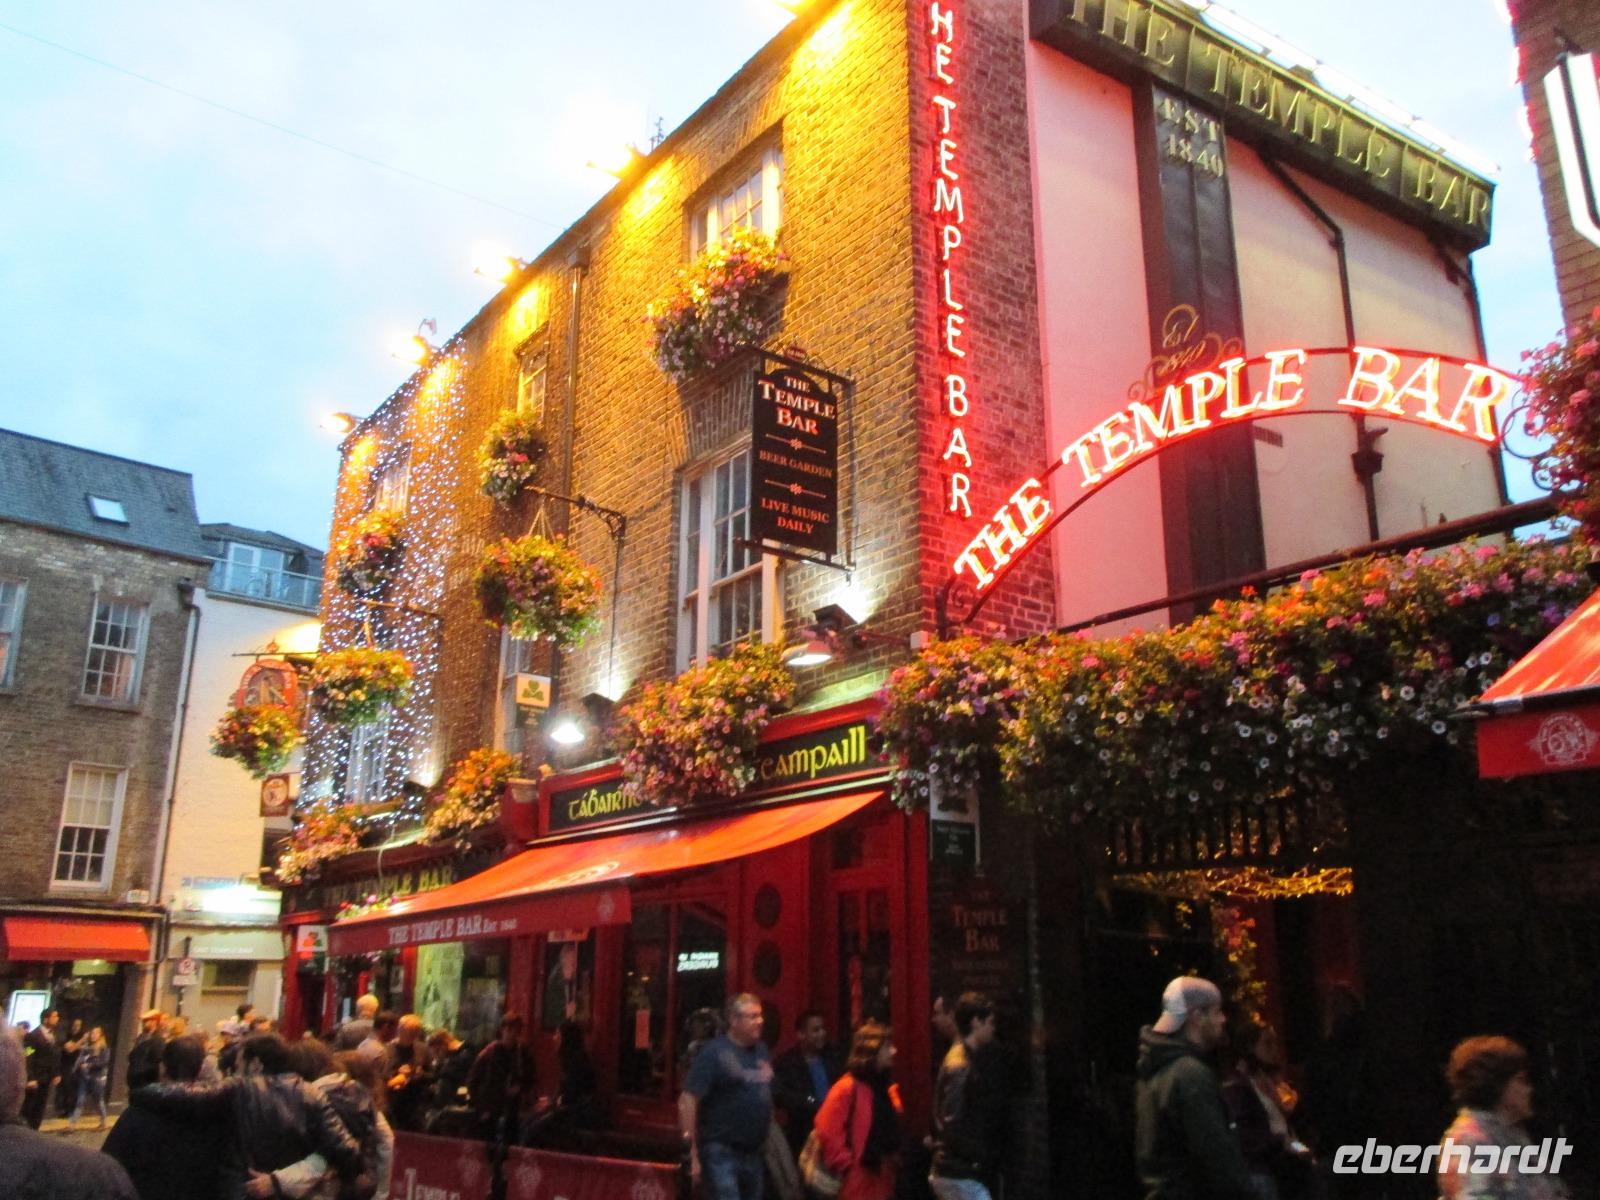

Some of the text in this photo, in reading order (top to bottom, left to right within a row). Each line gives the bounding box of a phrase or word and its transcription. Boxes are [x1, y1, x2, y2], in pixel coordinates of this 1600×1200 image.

[1203, 41, 1392, 178] TEMPLE
[1415, 154, 1490, 228] BAR
[933, 95, 966, 358] TEMPLE
[757, 379, 836, 419] TEMPLE
[783, 375, 811, 393] THE
[776, 406, 819, 436] BAR
[943, 372, 972, 517] BAR
[759, 449, 834, 478] BEER GARDEN
[953, 346, 1514, 590] THE TEMPLE BAR
[761, 497, 830, 524] LIVE MUSIC
[776, 515, 814, 535] DAILY
[387, 924, 410, 945] THE
[411, 918, 456, 942] TEMPLE
[456, 913, 483, 937] BAR
